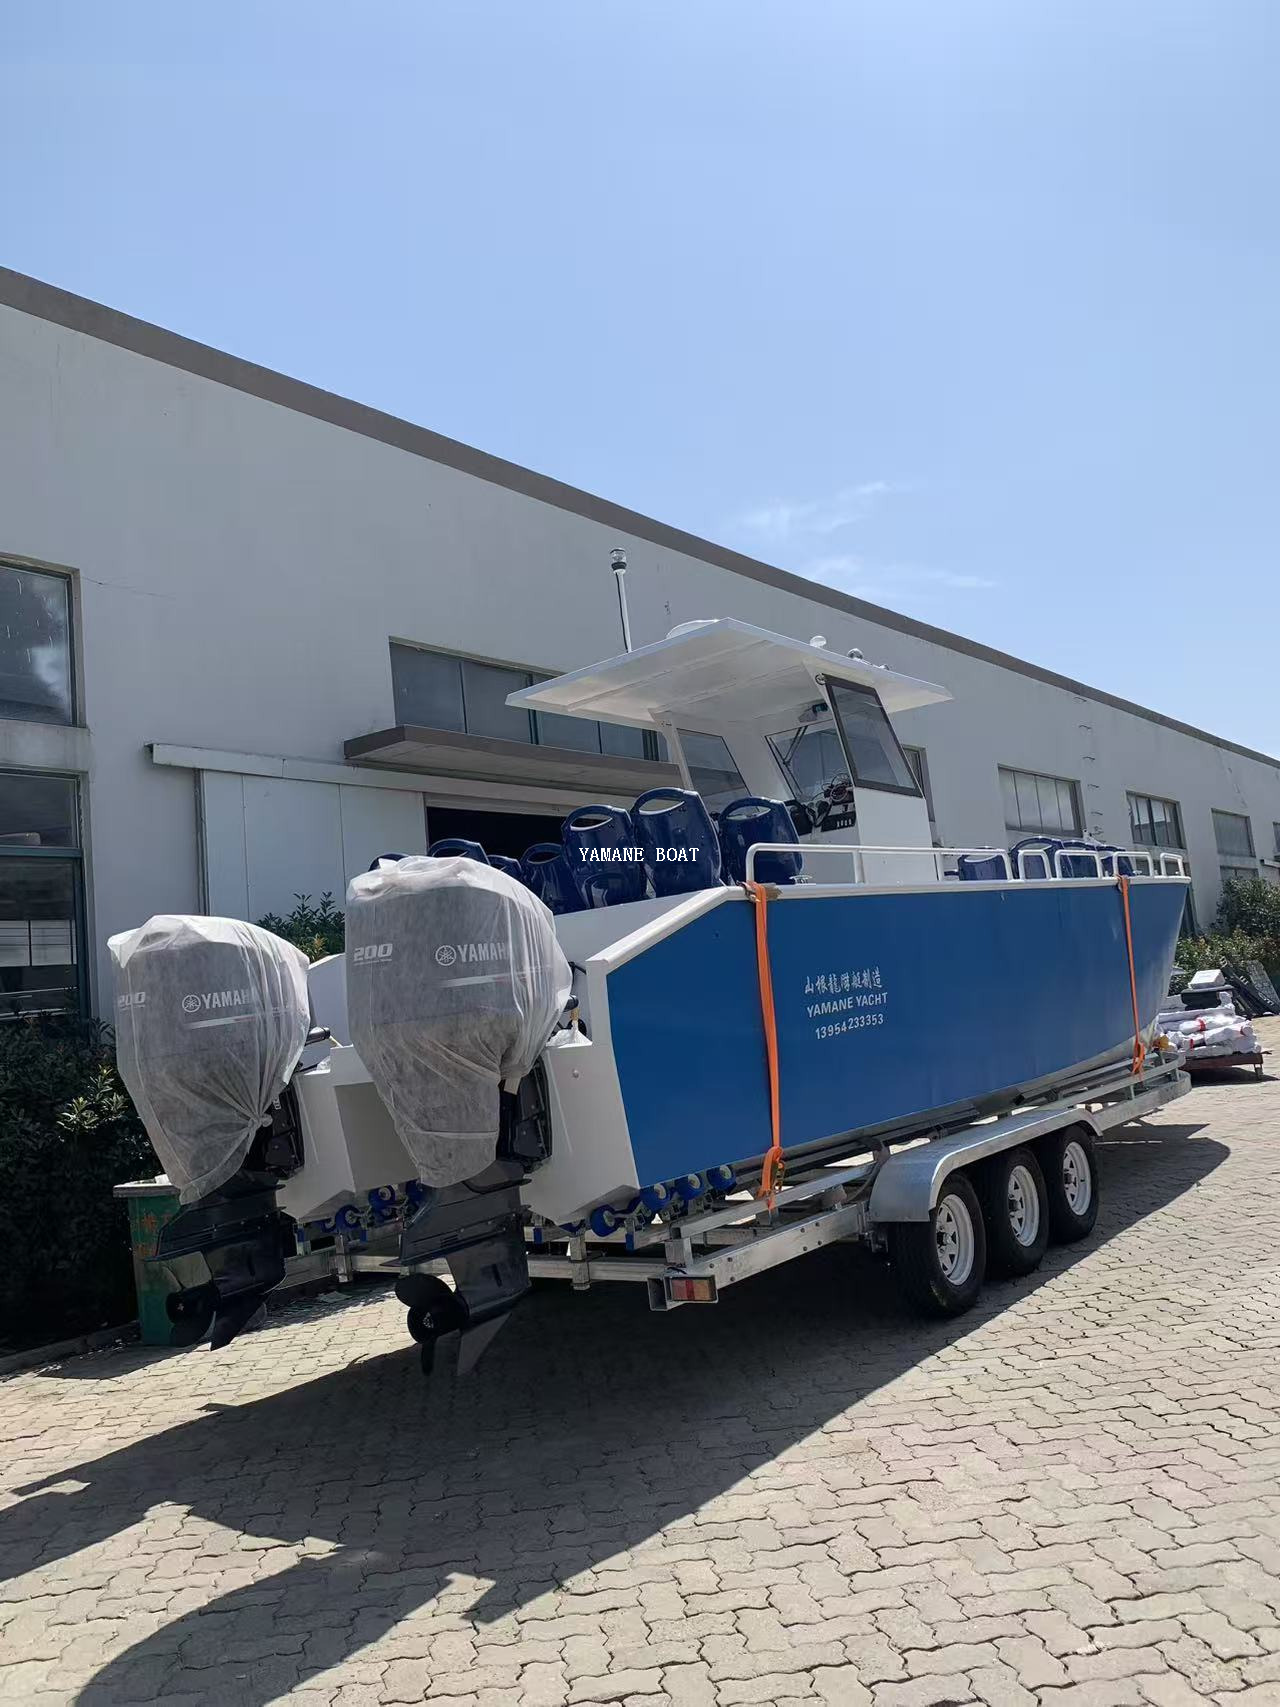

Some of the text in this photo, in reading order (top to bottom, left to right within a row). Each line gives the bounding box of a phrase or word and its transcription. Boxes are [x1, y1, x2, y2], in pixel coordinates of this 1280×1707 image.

[353, 943, 393, 961] 200
[457, 942, 512, 962] YAMAH
[201, 989, 255, 1009] YAMAH
[807, 992, 888, 1018] YAMANE YACHT
[815, 1013, 884, 1040] 13954233353
